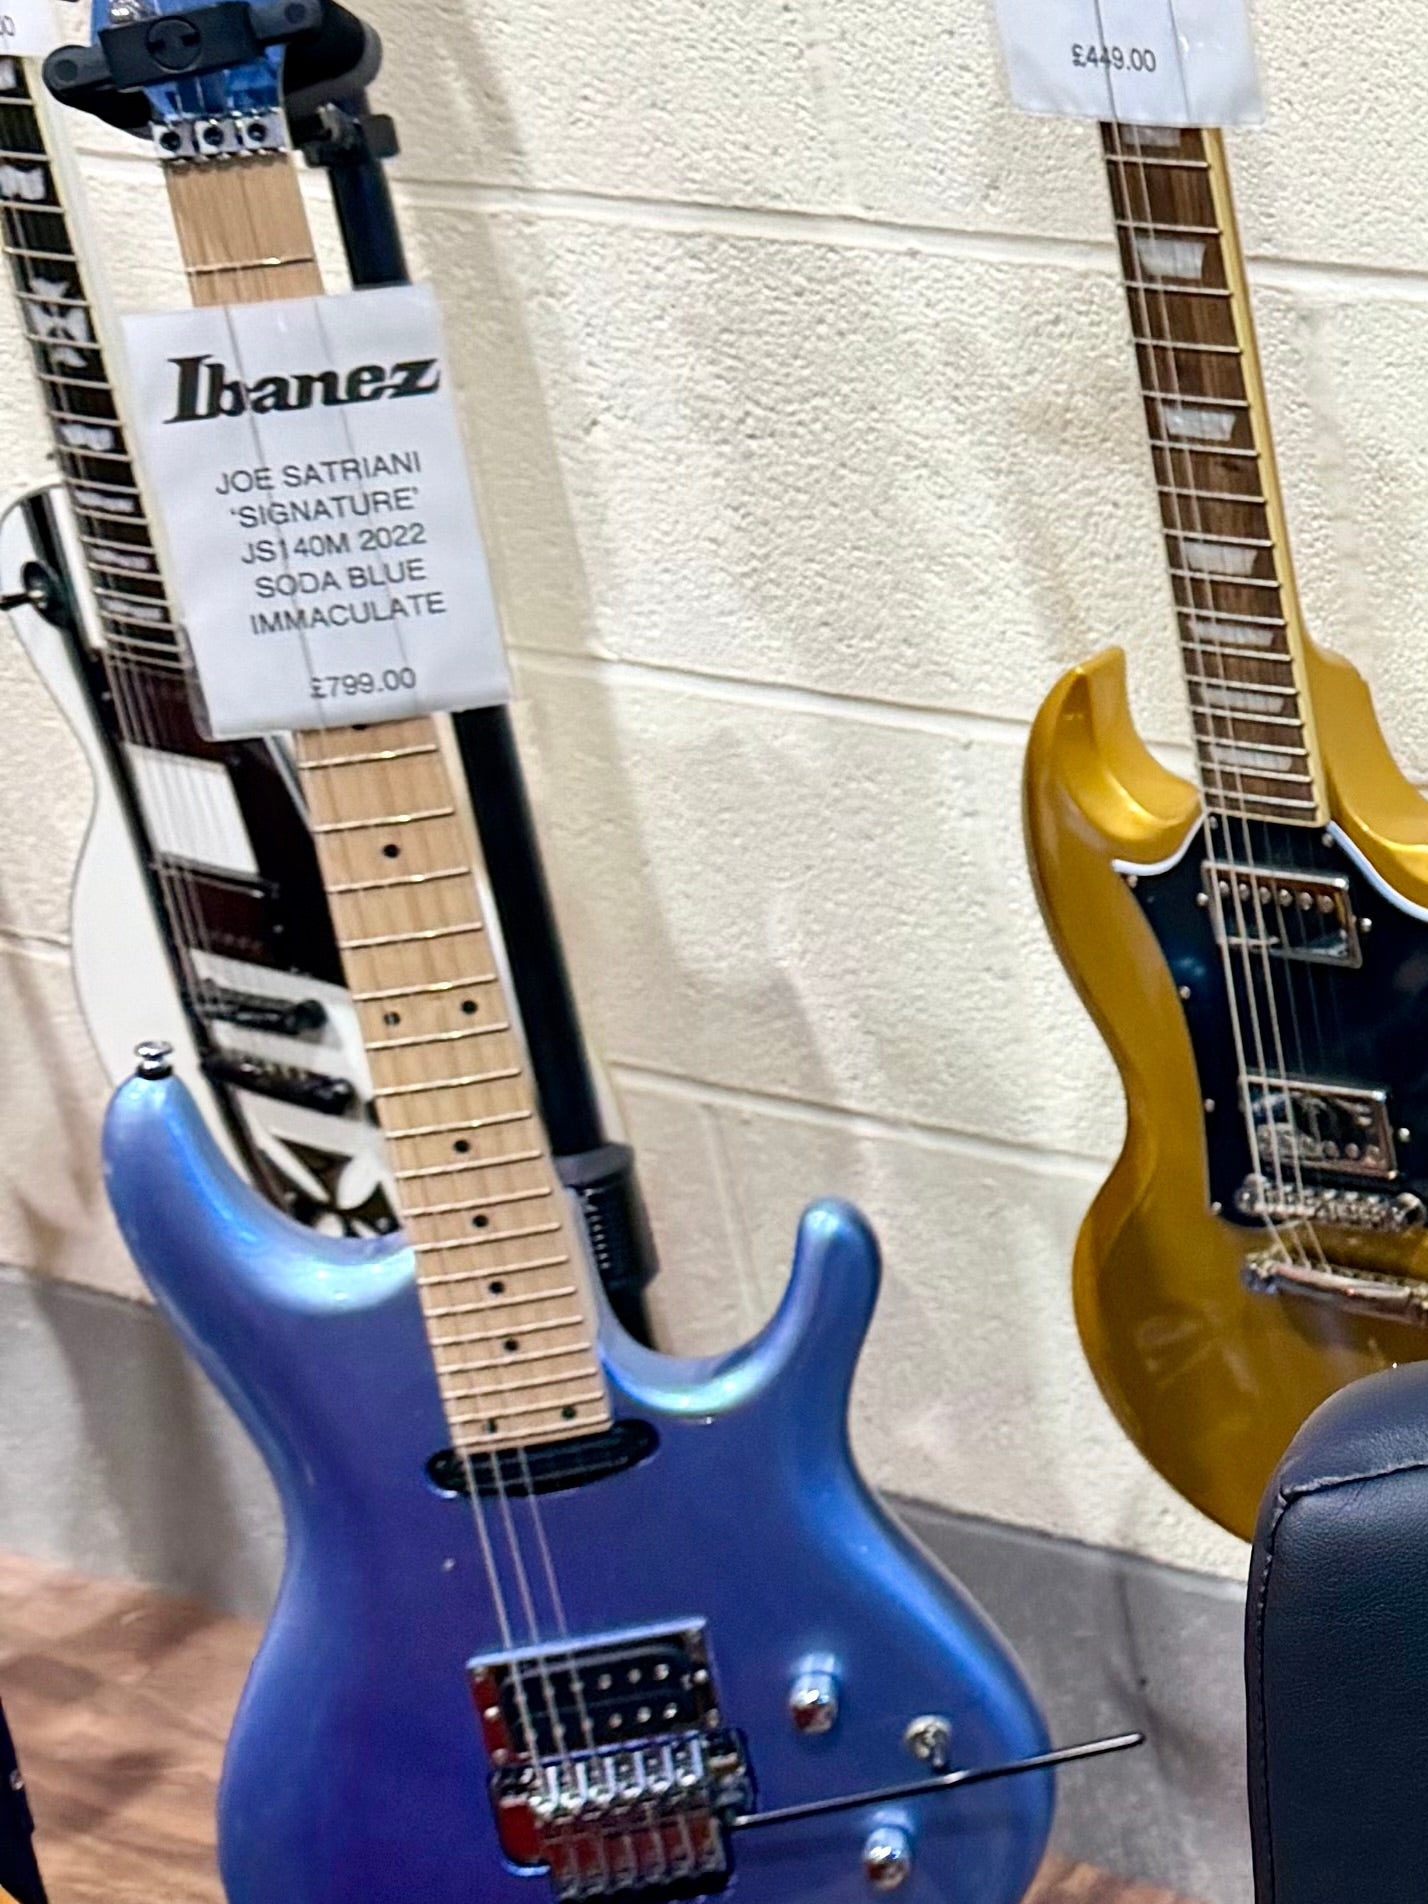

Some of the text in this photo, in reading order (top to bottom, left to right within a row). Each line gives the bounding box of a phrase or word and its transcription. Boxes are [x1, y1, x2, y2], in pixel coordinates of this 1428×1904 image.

[1072, 44, 1158, 73] £449.00
[163, 352, 443, 424] Ibanez
[215, 450, 423, 497] JOE SATRIANI
[240, 522, 428, 566] JS140M 2022
[254, 558, 429, 599] SODA BLUE
[250, 591, 448, 636] IMMACULATE
[310, 667, 418, 700] £799.00
